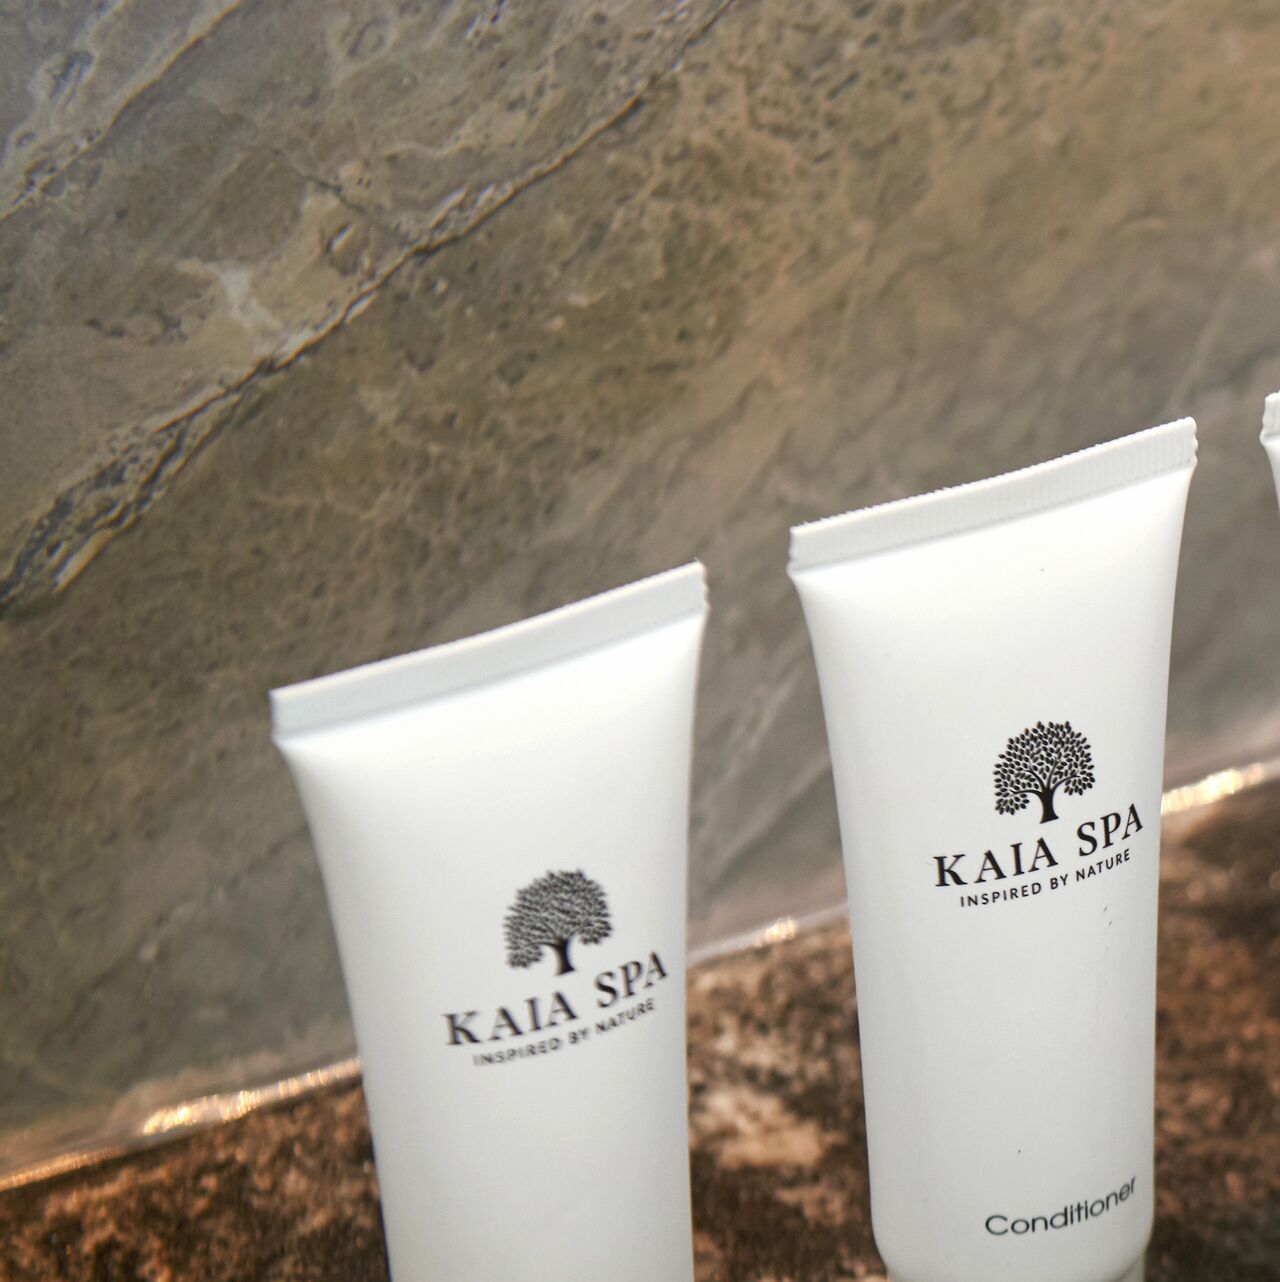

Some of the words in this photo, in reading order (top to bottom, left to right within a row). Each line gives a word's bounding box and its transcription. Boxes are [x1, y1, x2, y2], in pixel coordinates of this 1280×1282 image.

[932, 837, 1058, 887] KAIA
[1077, 803, 1143, 857] SPA
[960, 882, 1042, 907] INSPIRED
[1050, 874, 1069, 890] BY
[1076, 849, 1131, 882] NATURE
[442, 991, 578, 1046] KAIA
[594, 951, 668, 1008] SPA
[473, 1037, 561, 1066] INSPIRED
[569, 1028, 589, 1045] BY
[595, 998, 656, 1035] NATURE
[985, 1176, 1136, 1236] Conditioner
